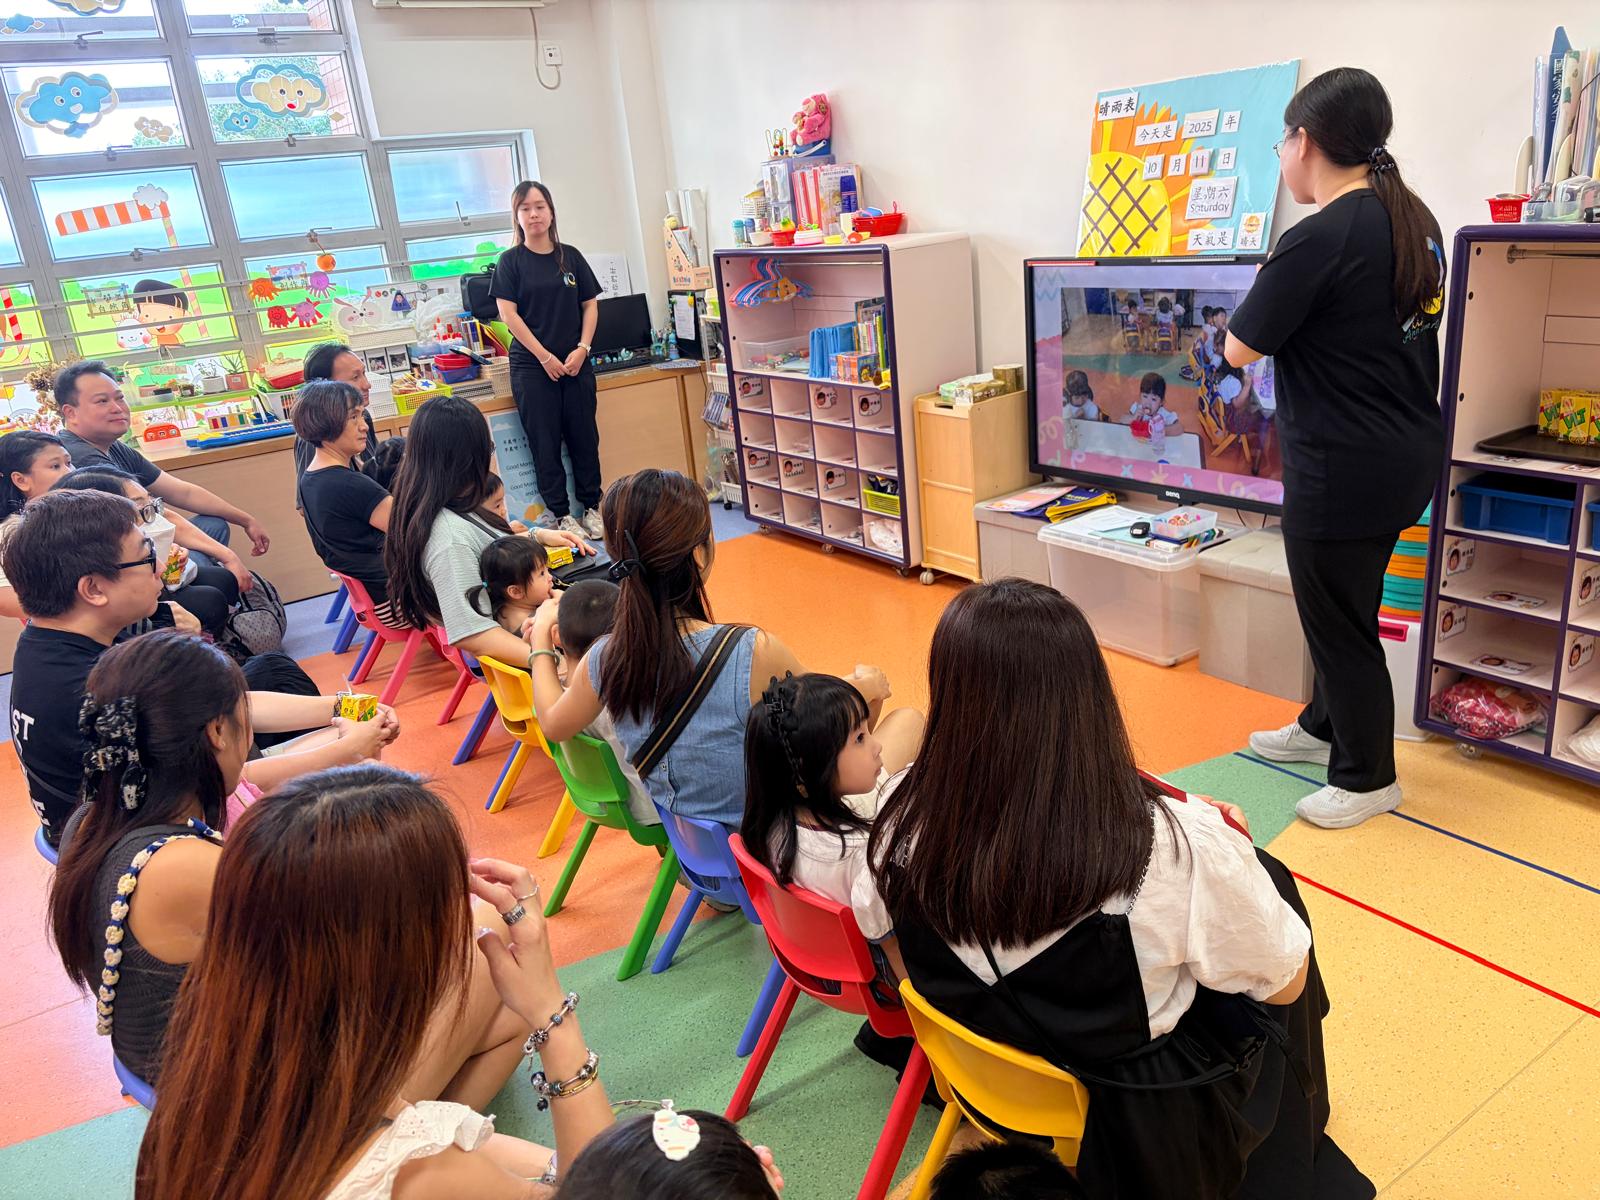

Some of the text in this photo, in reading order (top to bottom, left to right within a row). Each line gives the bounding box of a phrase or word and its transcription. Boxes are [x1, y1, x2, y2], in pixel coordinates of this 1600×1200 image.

[1098, 96, 1136, 117] 晴雨表
[1139, 114, 1237, 141] 今天是 2025 年
[1147, 151, 1231, 173] 10 月 11 日
[1191, 186, 1230, 201] 星期六
[1190, 201, 1230, 214] Saturday
[1192, 231, 1257, 247] 天氣是 晴天
